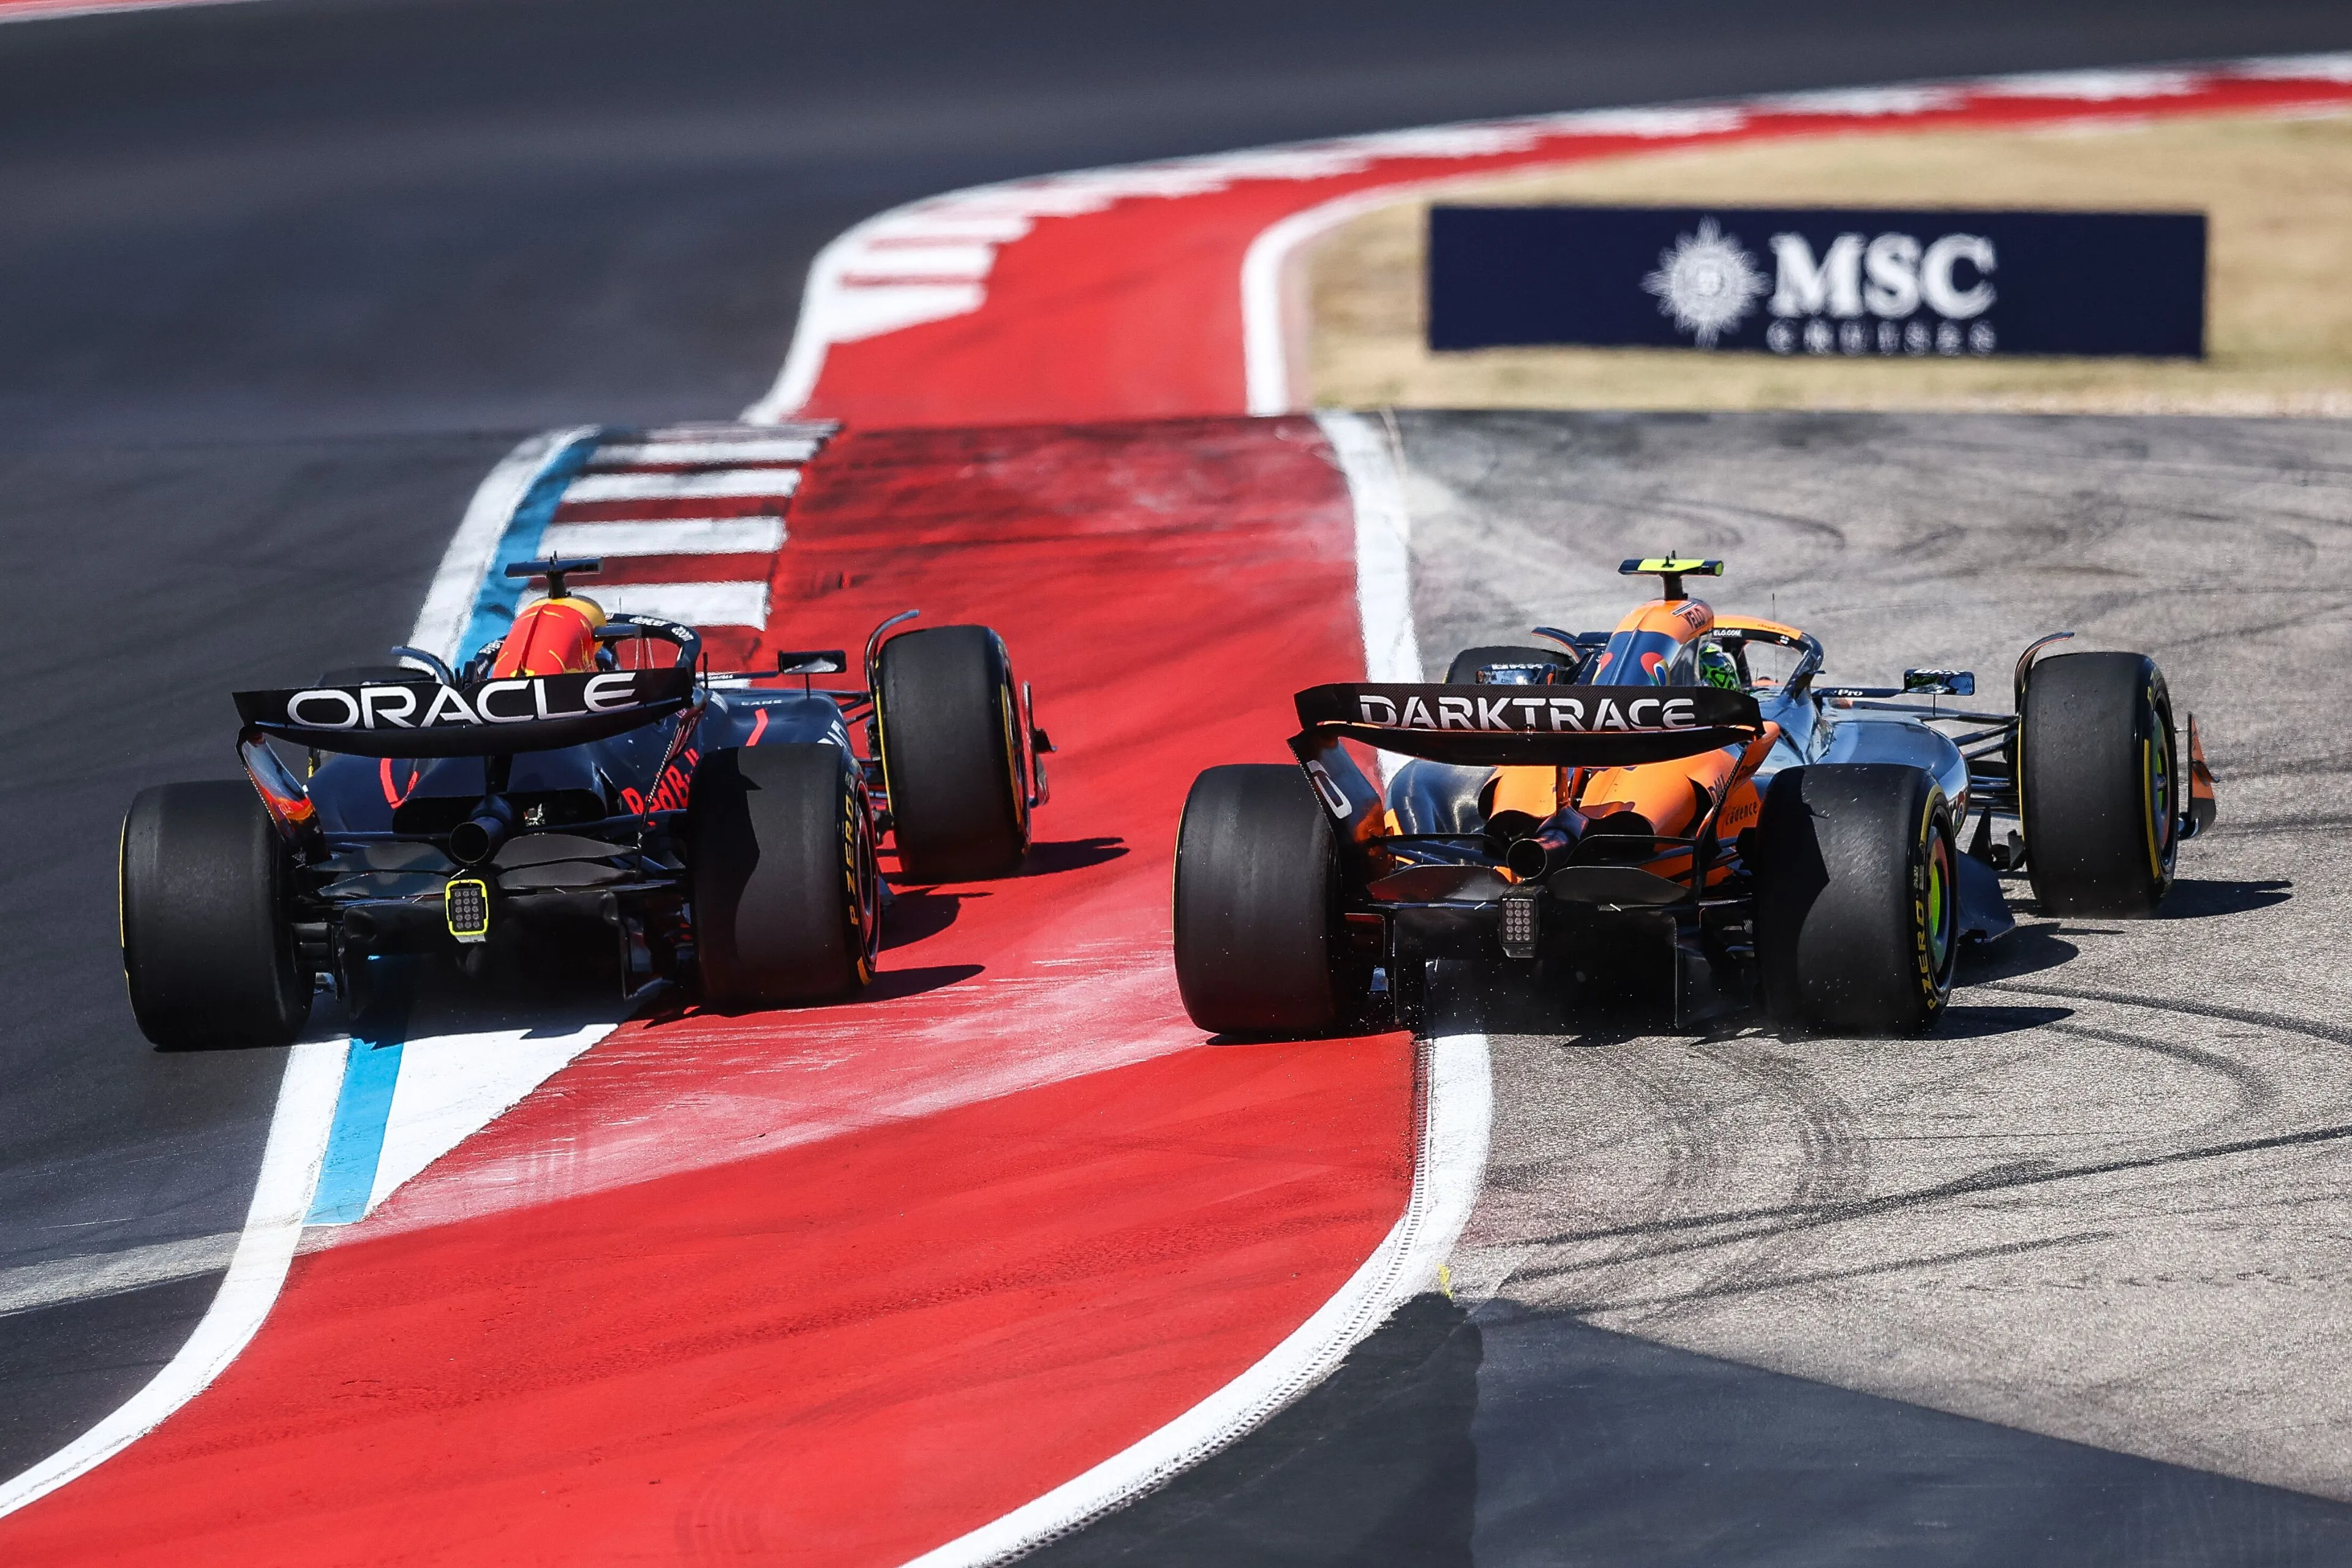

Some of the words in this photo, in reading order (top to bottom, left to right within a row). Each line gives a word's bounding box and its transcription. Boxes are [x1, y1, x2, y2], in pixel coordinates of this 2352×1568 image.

[1767, 232, 1998, 320] MSC
[287, 673, 639, 729] ORACLE
[1360, 695, 1695, 731] DARKTRACE
[845, 793, 857, 895] ZERO
[1916, 900, 1932, 994] ZERO
